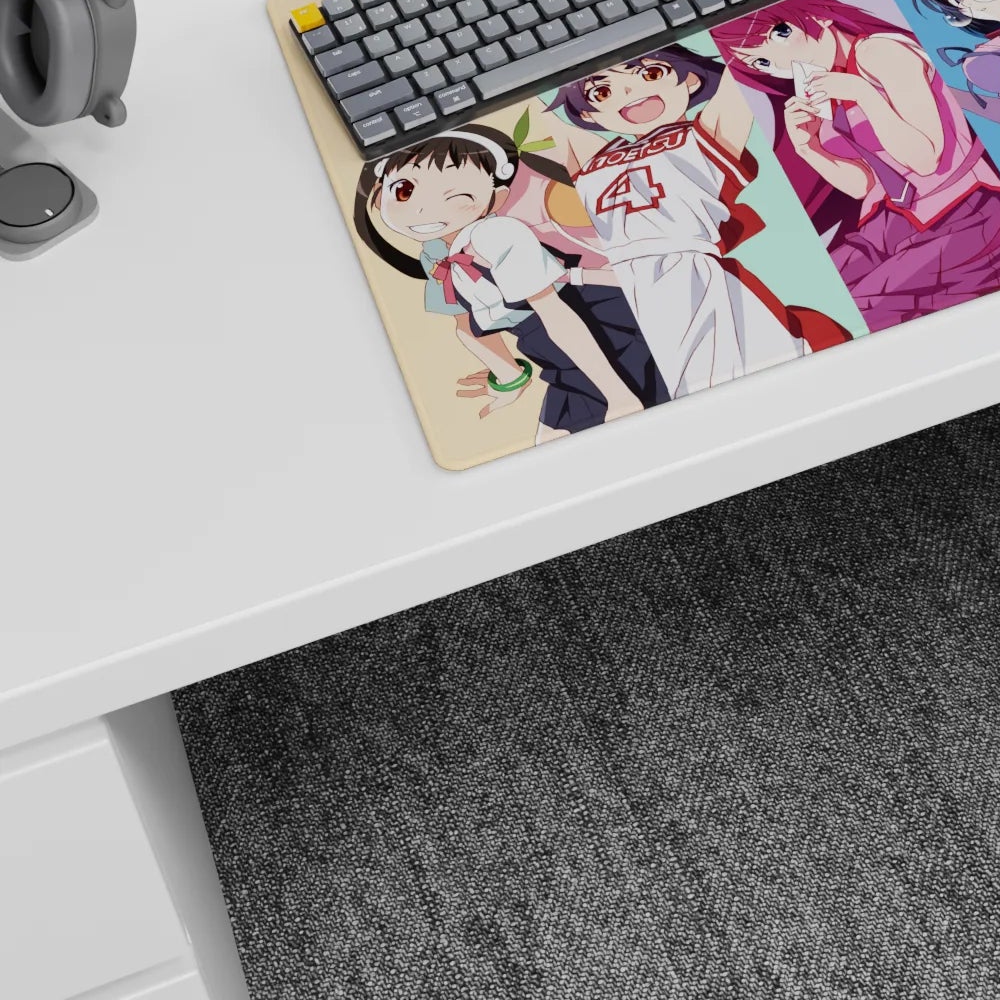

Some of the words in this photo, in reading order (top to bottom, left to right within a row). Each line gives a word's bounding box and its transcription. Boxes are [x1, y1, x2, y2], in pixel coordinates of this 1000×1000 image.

[438, 84, 467, 99] command
[403, 102, 423, 112] option
[362, 116, 383, 128] control
[596, 165, 666, 215] 4
